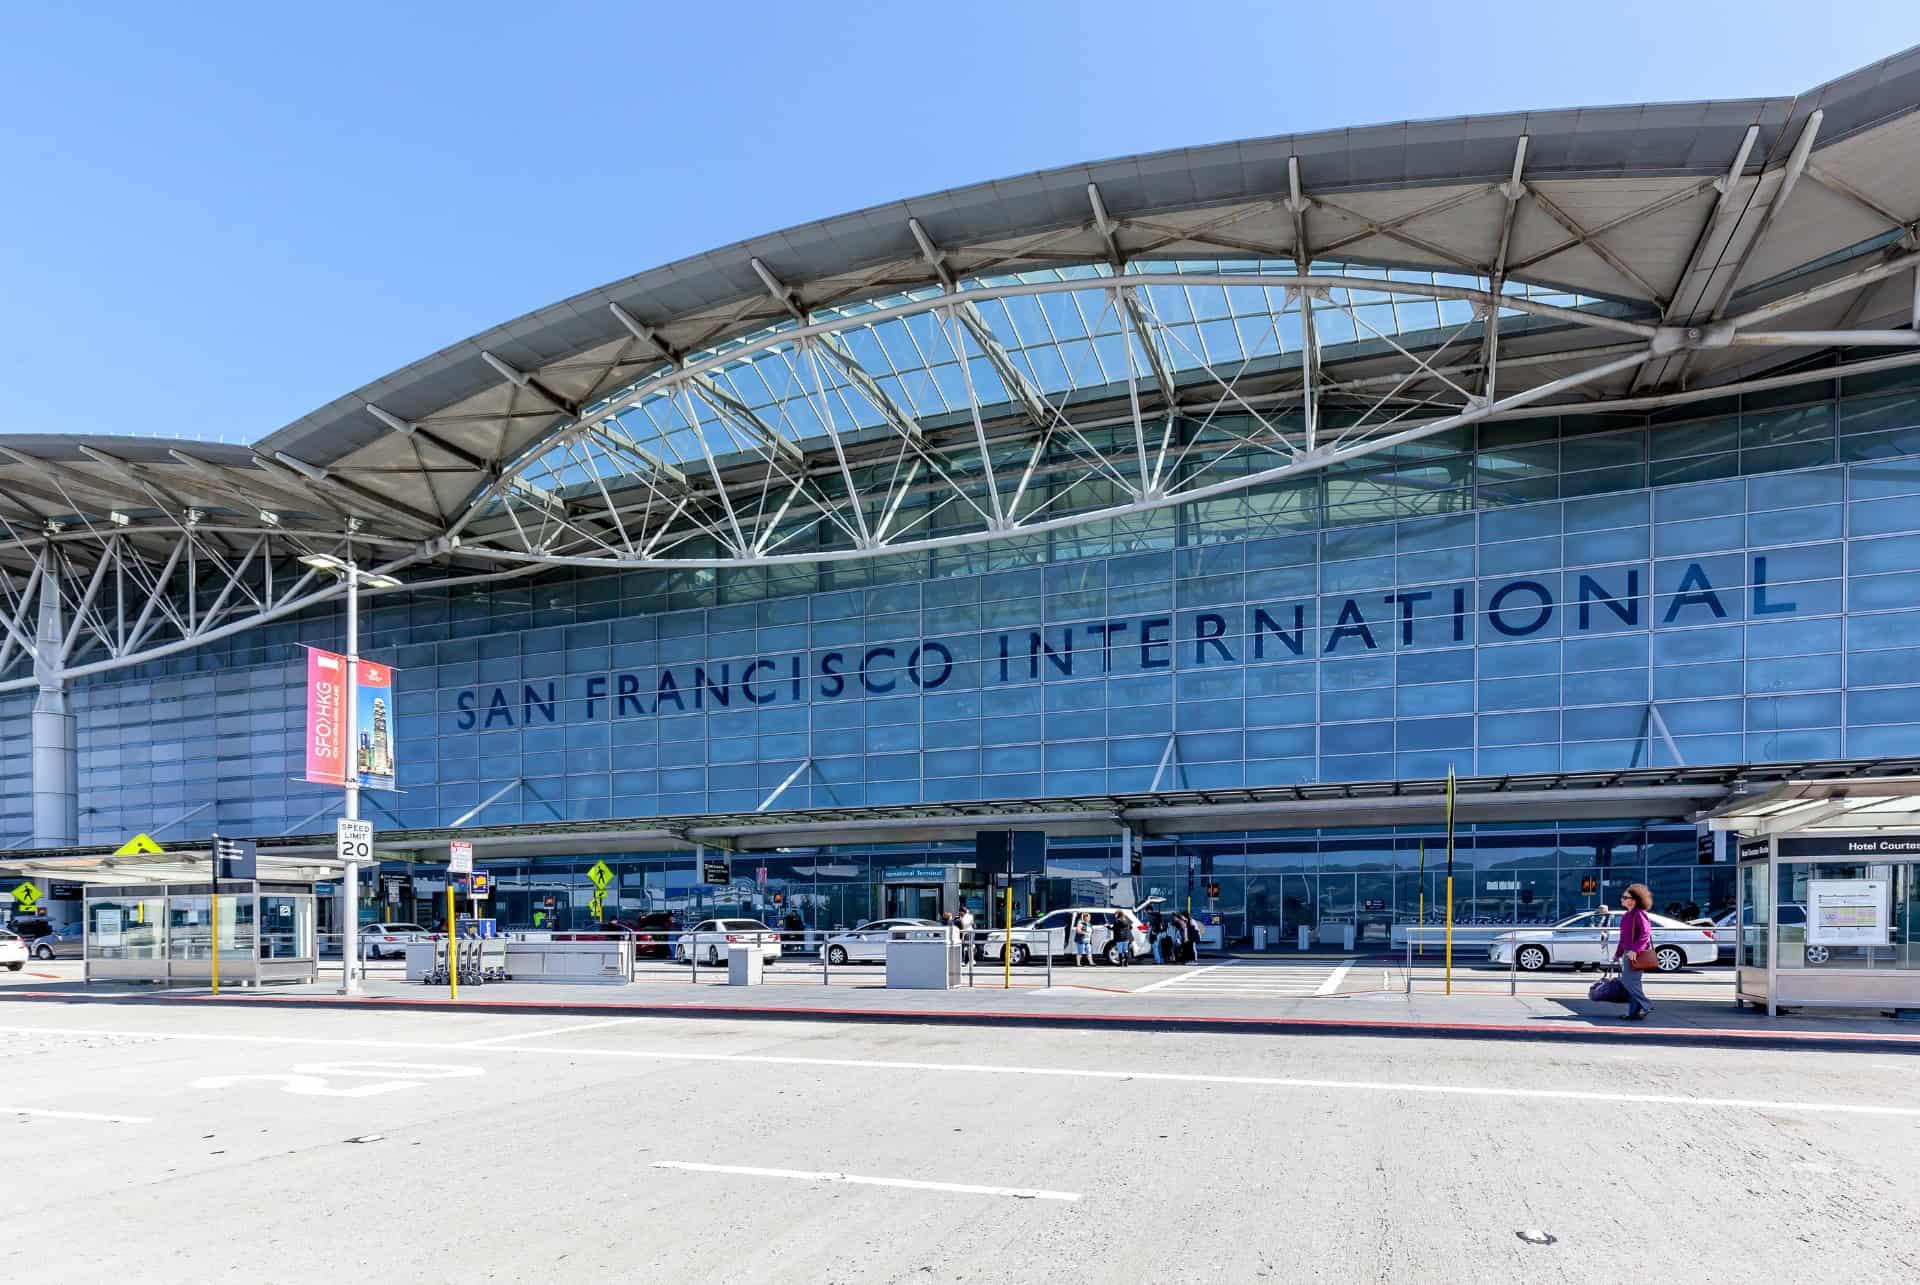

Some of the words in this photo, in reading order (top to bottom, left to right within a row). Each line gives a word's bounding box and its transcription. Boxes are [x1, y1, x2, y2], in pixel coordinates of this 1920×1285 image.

[457, 680, 556, 730] SAN
[586, 641, 953, 719] FRANCISCO
[1000, 556, 1797, 681] INTERNATIONAL
[341, 823, 370, 832] SPEED
[344, 832, 368, 840] LIMIT
[342, 841, 369, 857] 20
[1848, 841, 1877, 851] Hotel
